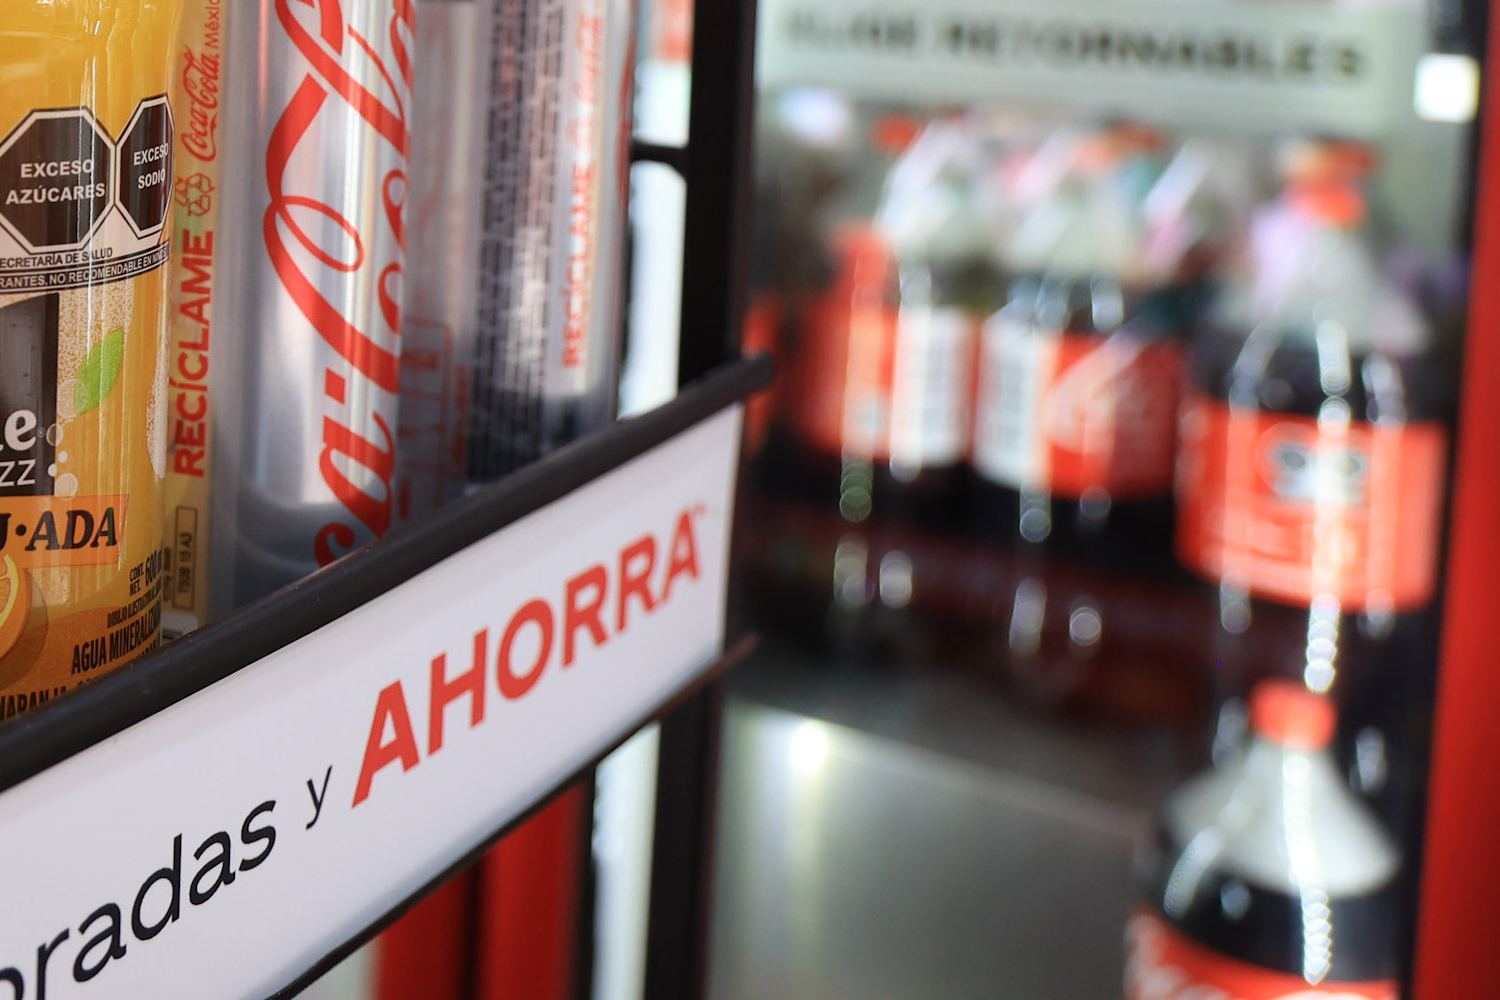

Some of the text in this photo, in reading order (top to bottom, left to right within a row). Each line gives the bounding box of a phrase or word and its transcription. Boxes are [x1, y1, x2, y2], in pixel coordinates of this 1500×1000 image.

[181, 44, 219, 162] Coca-Cola
[132, 142, 169, 166] EXCESO
[20, 158, 95, 179] EXCESO
[137, 168, 166, 190] SODIO
[5, 182, 106, 206] AZÚCARES
[64, 250, 79, 263] DE
[81, 247, 114, 262] SALUD
[49, 272, 66, 287] NO
[67, 259, 144, 284] RECOMENDABLE
[168, 229, 214, 477] RECÍCLAME
[71, 637, 107, 675] AGUA
[305, 763, 333, 831] y
[350, 509, 699, 809] AHORRA
